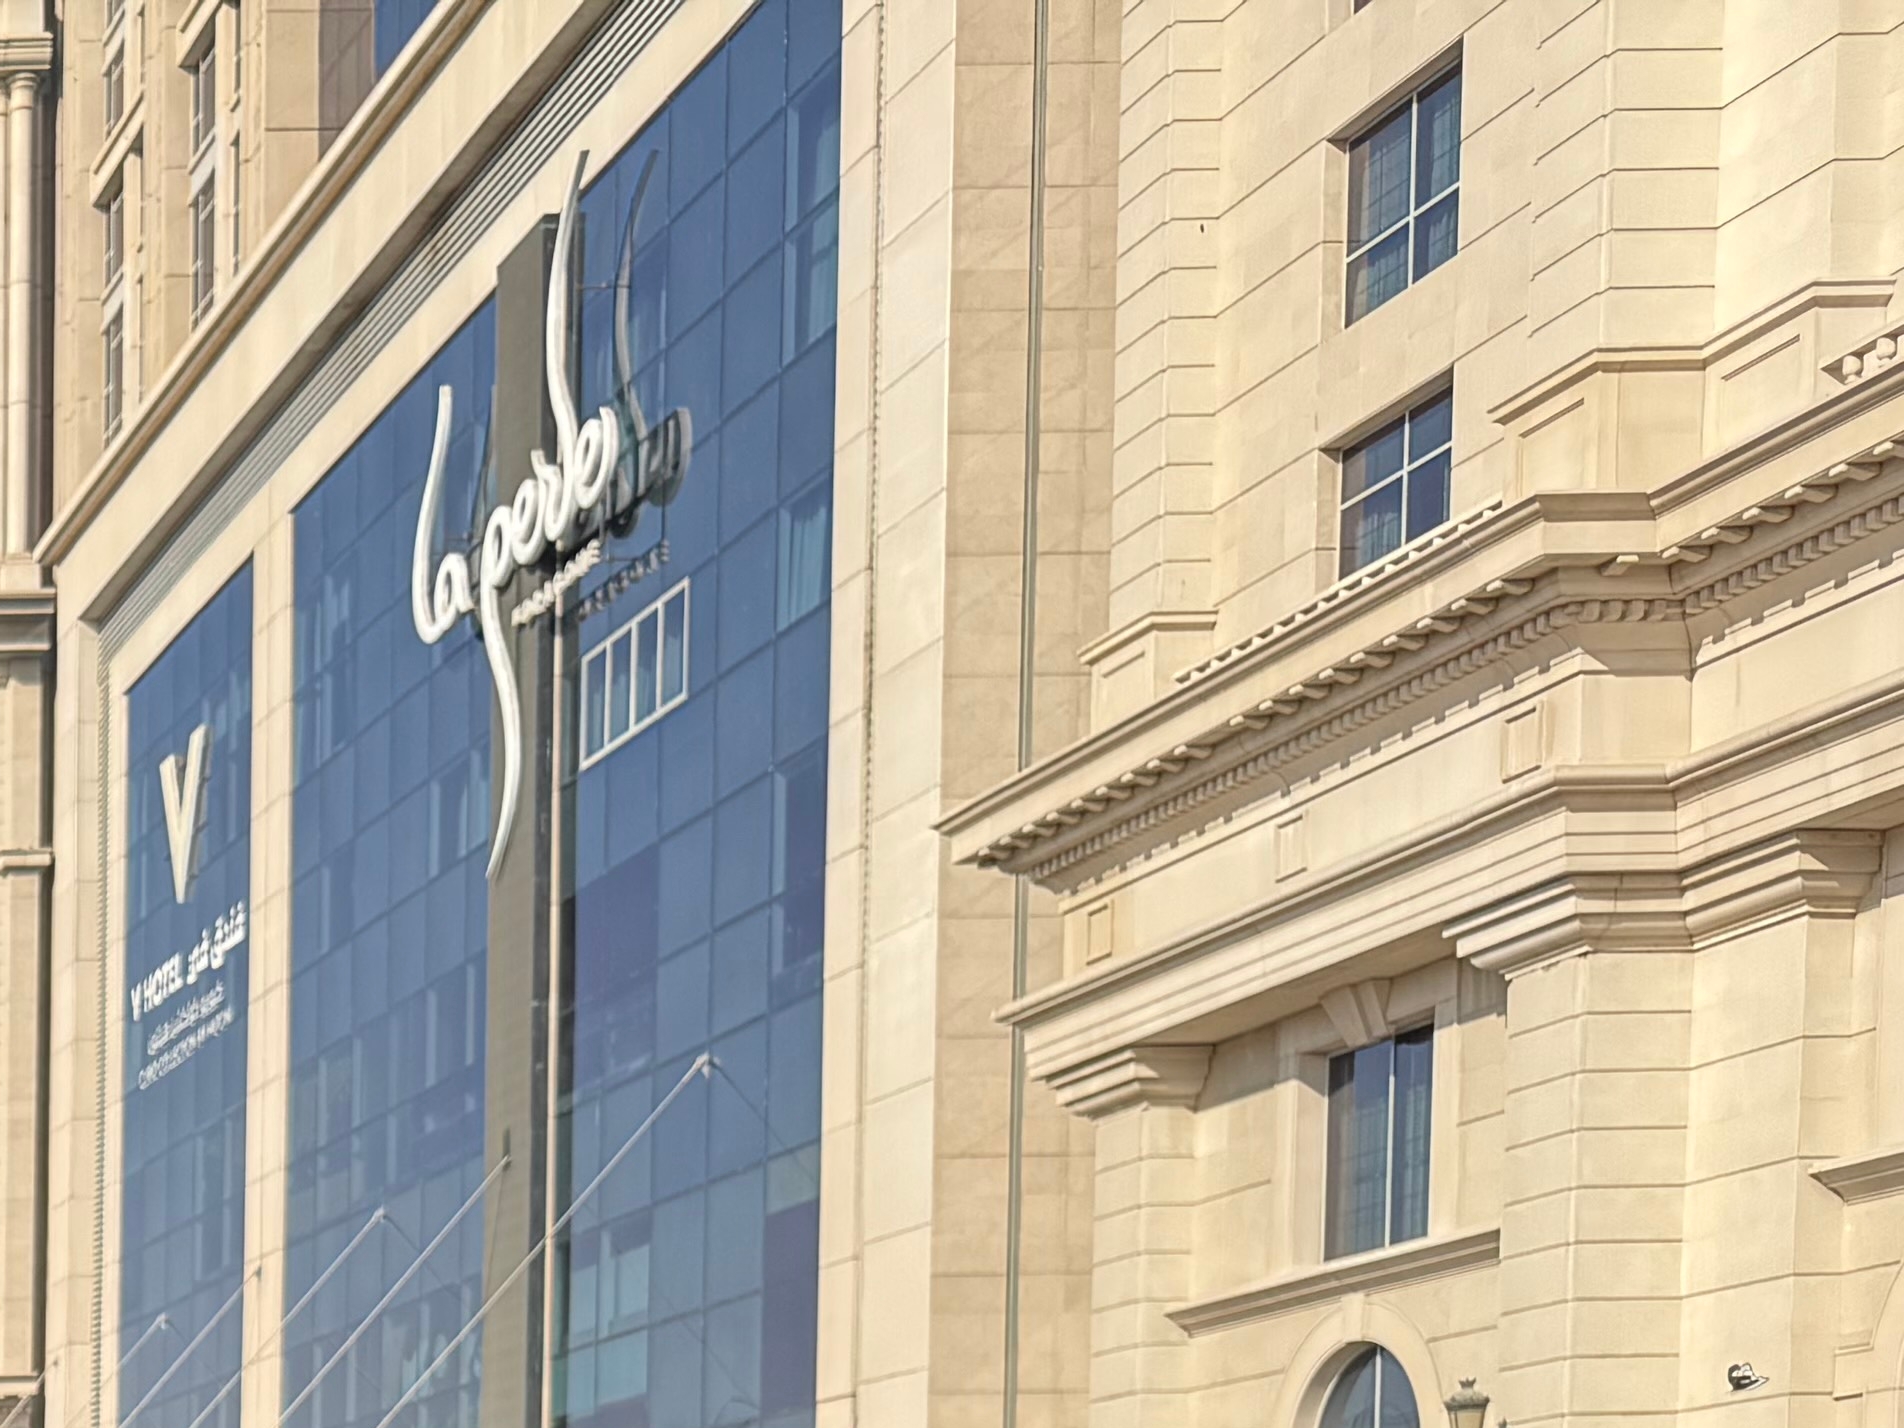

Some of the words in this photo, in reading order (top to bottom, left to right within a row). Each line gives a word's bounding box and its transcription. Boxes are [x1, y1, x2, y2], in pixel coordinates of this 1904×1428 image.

[159, 724, 210, 904] V
[131, 982, 142, 1022] V
[144, 952, 184, 1013] HOTEL
